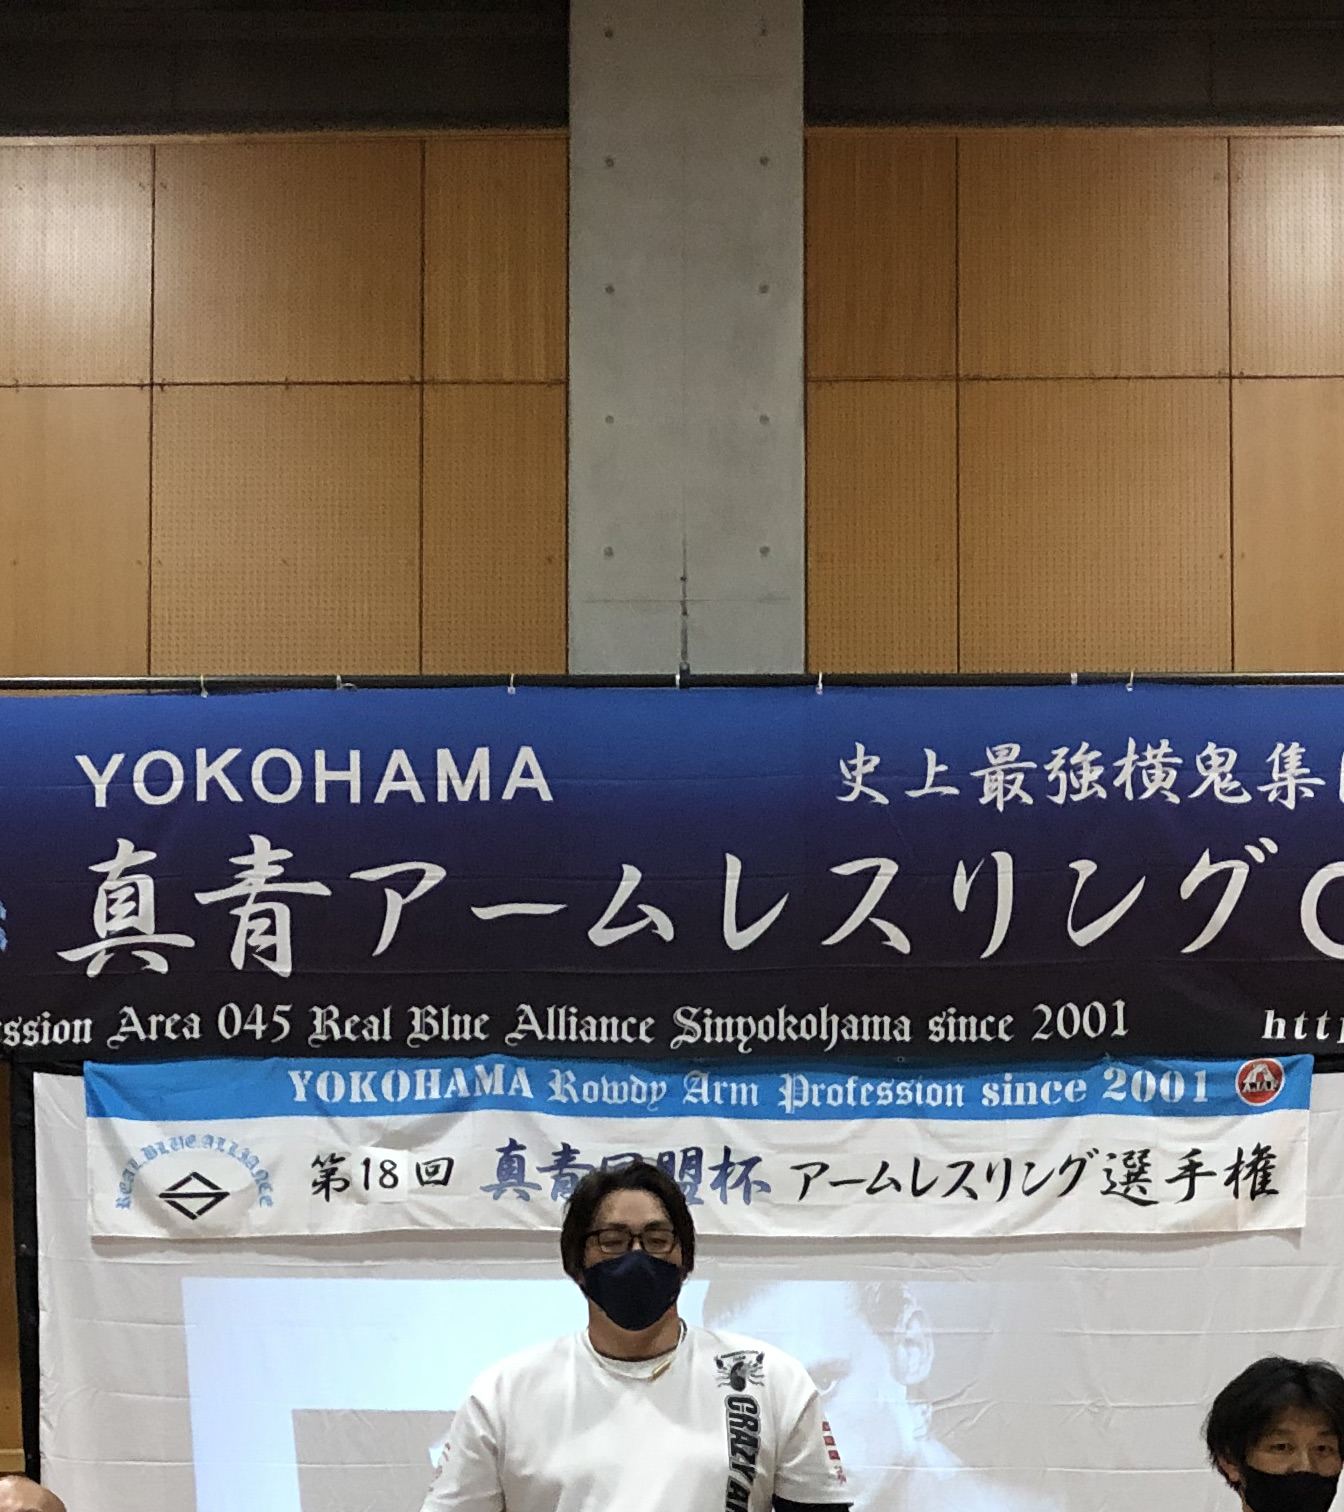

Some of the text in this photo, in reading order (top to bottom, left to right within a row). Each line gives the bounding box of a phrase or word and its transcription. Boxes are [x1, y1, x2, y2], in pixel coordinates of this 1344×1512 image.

[75, 746, 553, 808] YOKOHAMA
[106, 1005, 201, 1049] Area
[217, 1002, 292, 1043] 045
[307, 1004, 392, 1047] Real
[406, 1004, 490, 1048] Blue
[504, 1003, 655, 1046] Alliance
[669, 1004, 912, 1054] Sinyokohama
[928, 1007, 1014, 1043] since
[1031, 999, 1129, 1041] 2001
[288, 1063, 1209, 1114] YOKOHAMA Rowdy Arm Profession since 2001
[310, 1151, 454, 1204] 第18回
[789, 1144, 1281, 1206] アームレスリング選手権
[724, 1394, 761, 1485] CRAZY
